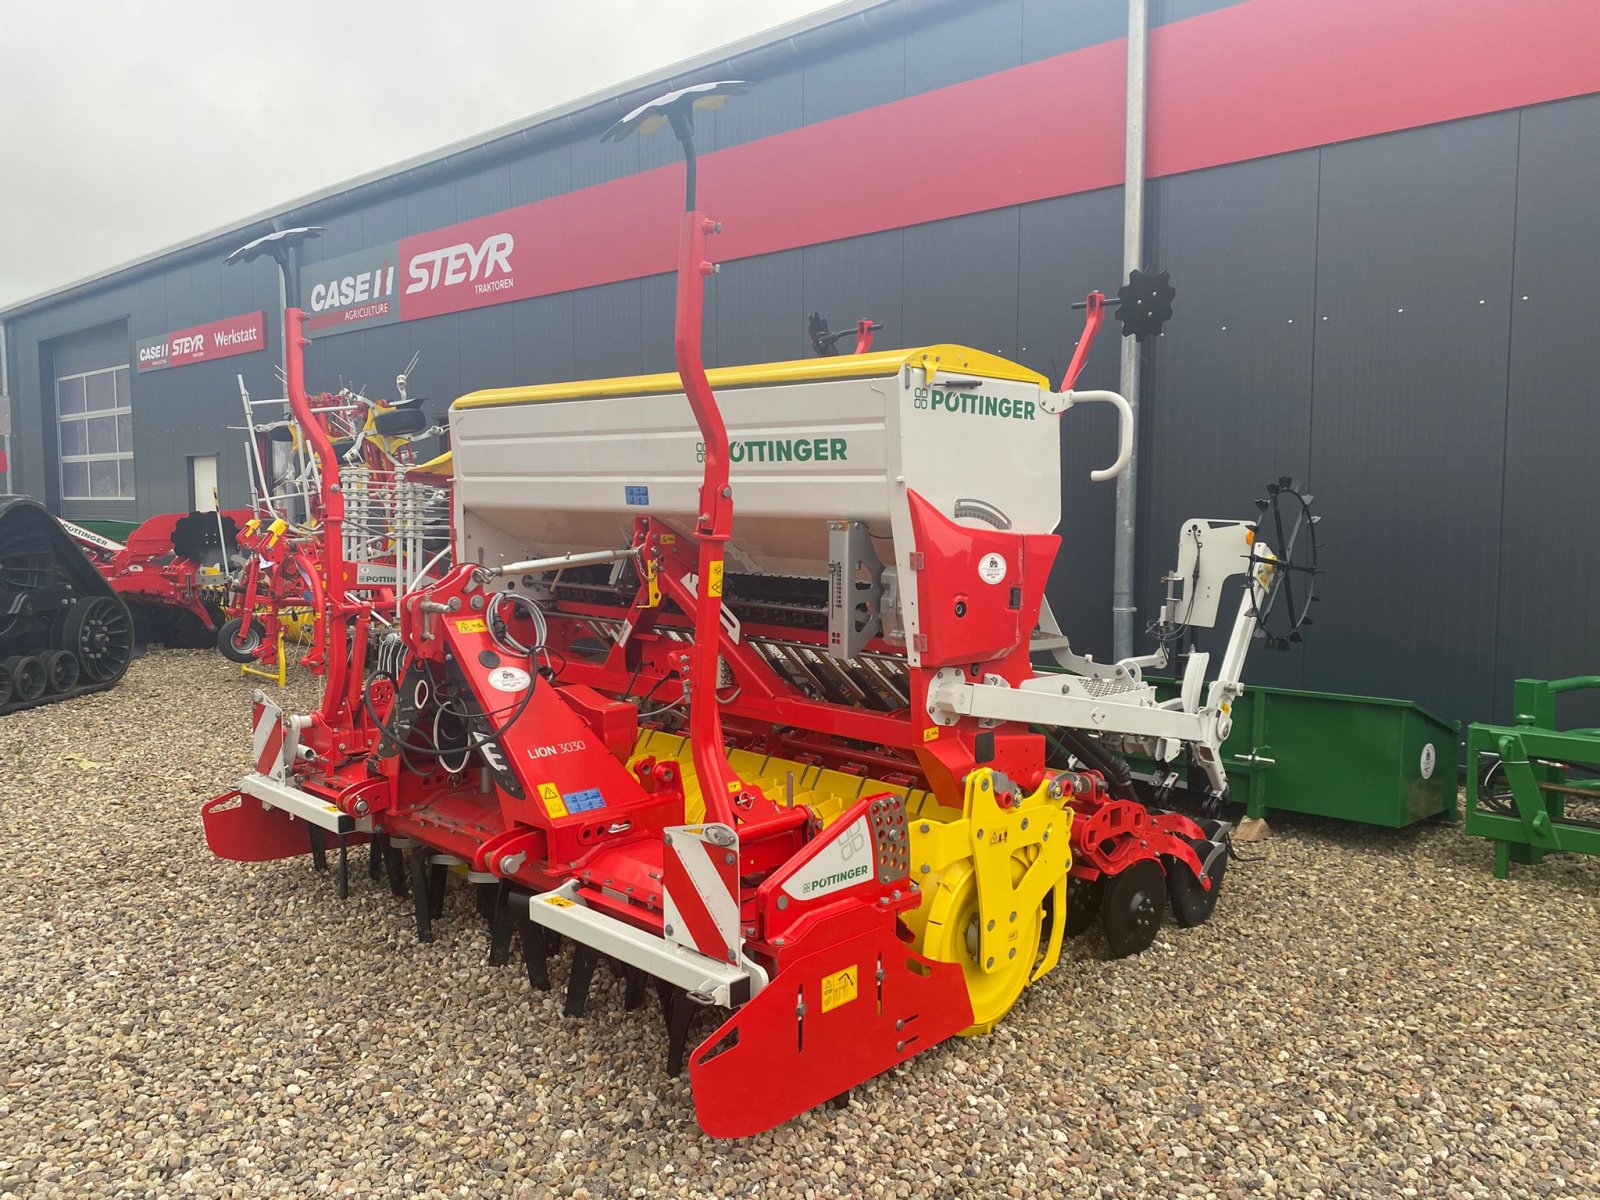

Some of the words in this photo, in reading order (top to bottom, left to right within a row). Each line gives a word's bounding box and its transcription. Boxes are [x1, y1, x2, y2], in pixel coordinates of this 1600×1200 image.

[405, 232, 514, 295] STEYR
[474, 278, 514, 295] TRAKTOREN
[344, 302, 389, 321] AGRICULTURE
[172, 334, 204, 356] STEYR
[213, 326, 257, 348] Werkstatt
[931, 389, 1036, 420] PÖTTINGER
[729, 438, 848, 463] ÖTTINGER
[527, 745, 557, 760] LION
[558, 740, 586, 755] 3030
